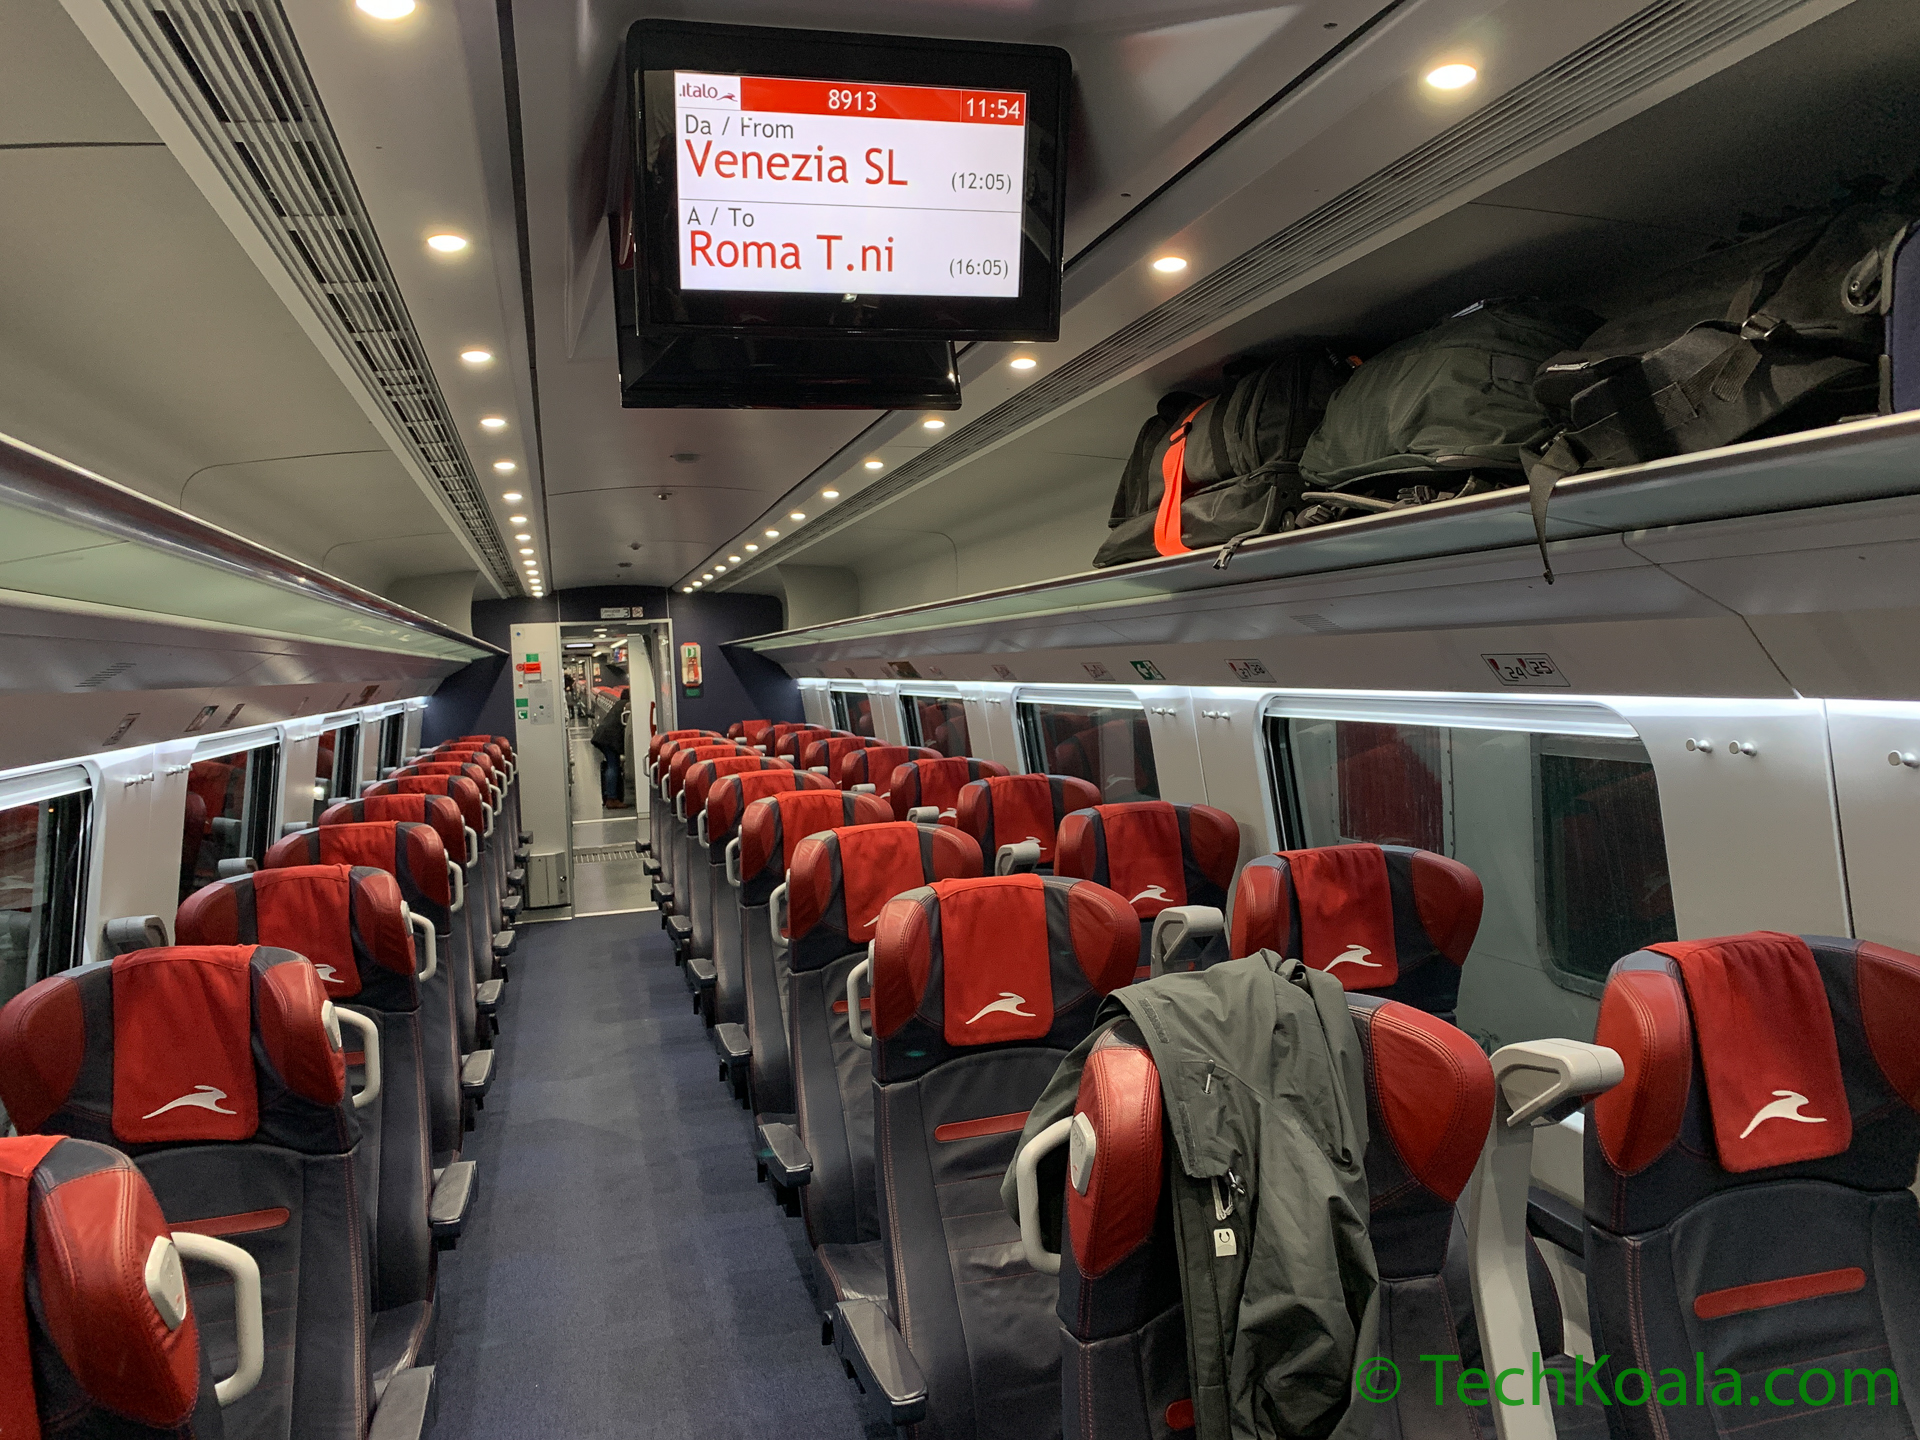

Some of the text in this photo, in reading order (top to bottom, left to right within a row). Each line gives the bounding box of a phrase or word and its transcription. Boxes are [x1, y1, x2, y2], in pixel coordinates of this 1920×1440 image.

[828, 89, 878, 112] 8913
[966, 97, 1021, 120] 11:54
[685, 114, 794, 139] Da / From
[685, 139, 908, 186] Venezia SL
[951, 172, 1012, 194] (12:05)
[687, 206, 755, 228] A / To
[690, 229, 895, 273] Roma T.ni
[949, 259, 1009, 279] (16:05)
[1504, 661, 1553, 679] 24 25
